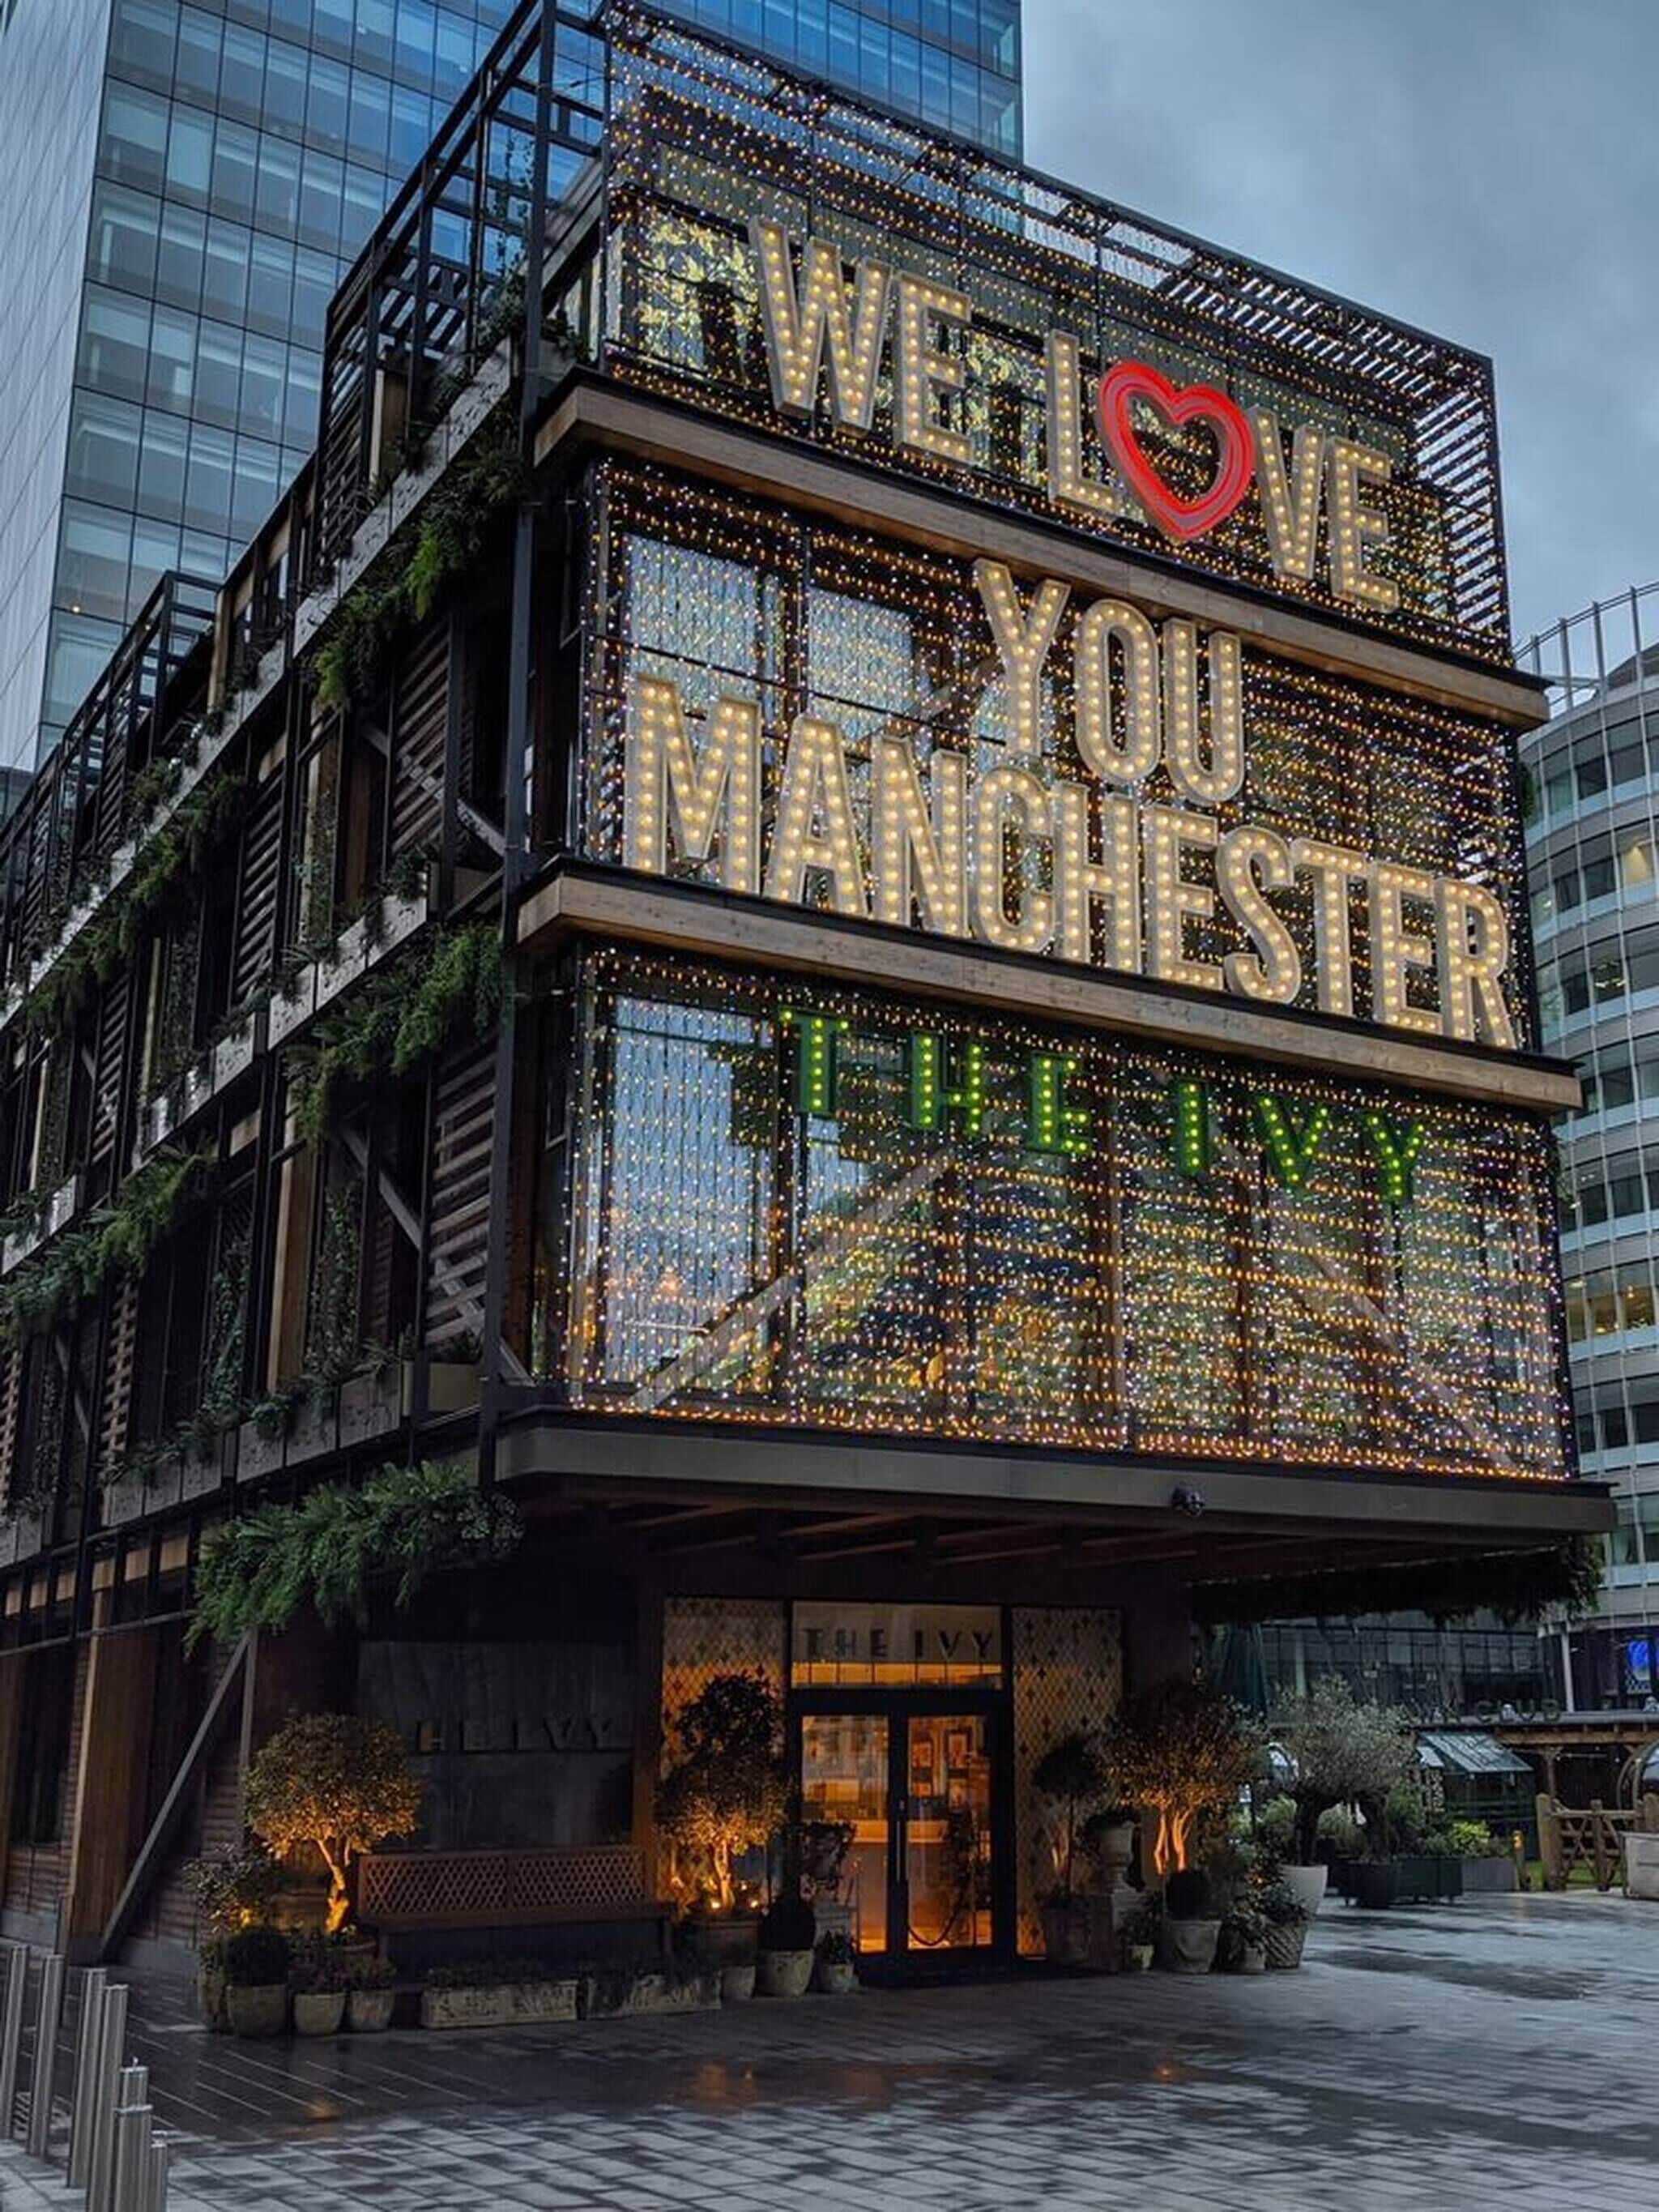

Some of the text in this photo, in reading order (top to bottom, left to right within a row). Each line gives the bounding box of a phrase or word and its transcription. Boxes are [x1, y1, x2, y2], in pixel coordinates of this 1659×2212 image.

[748, 217, 974, 465] WE
[973, 559, 1245, 805] YOU
[622, 673, 1517, 1050] MANCHESTER
[778, 1006, 1426, 1202] THE IVY
[800, 1628, 993, 1659] THE IVY
